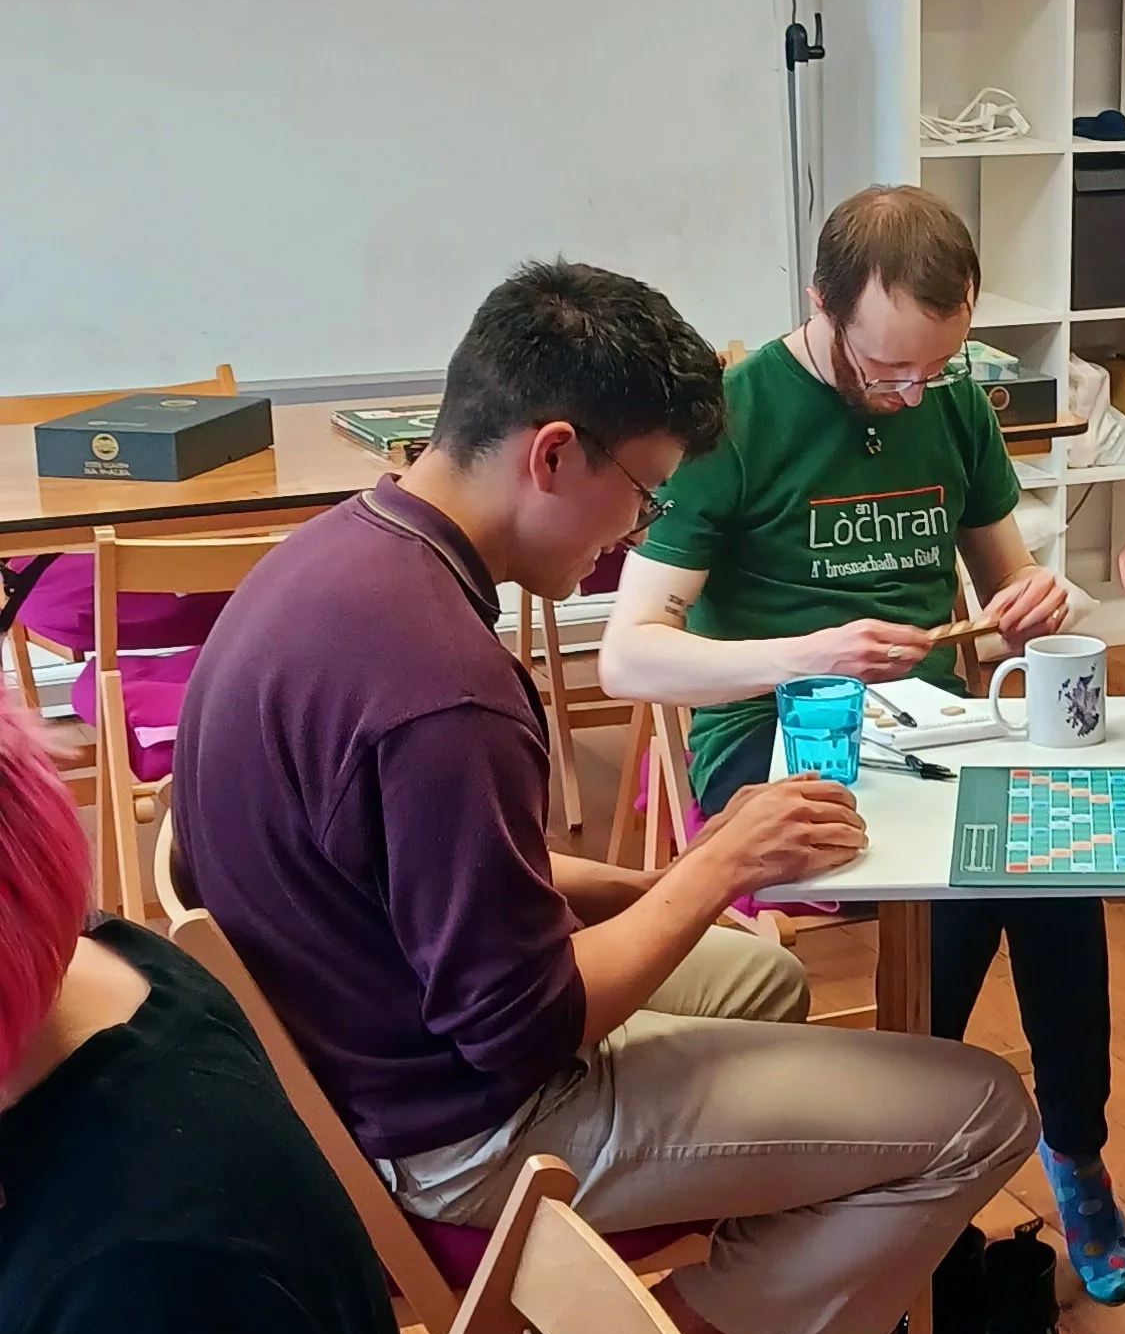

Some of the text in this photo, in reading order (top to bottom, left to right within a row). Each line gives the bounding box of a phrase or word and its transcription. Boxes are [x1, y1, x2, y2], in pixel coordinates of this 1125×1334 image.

[855, 503, 871, 515] an
[809, 501, 949, 549] Lòchran
[825, 552, 899, 578] brosnachadh
